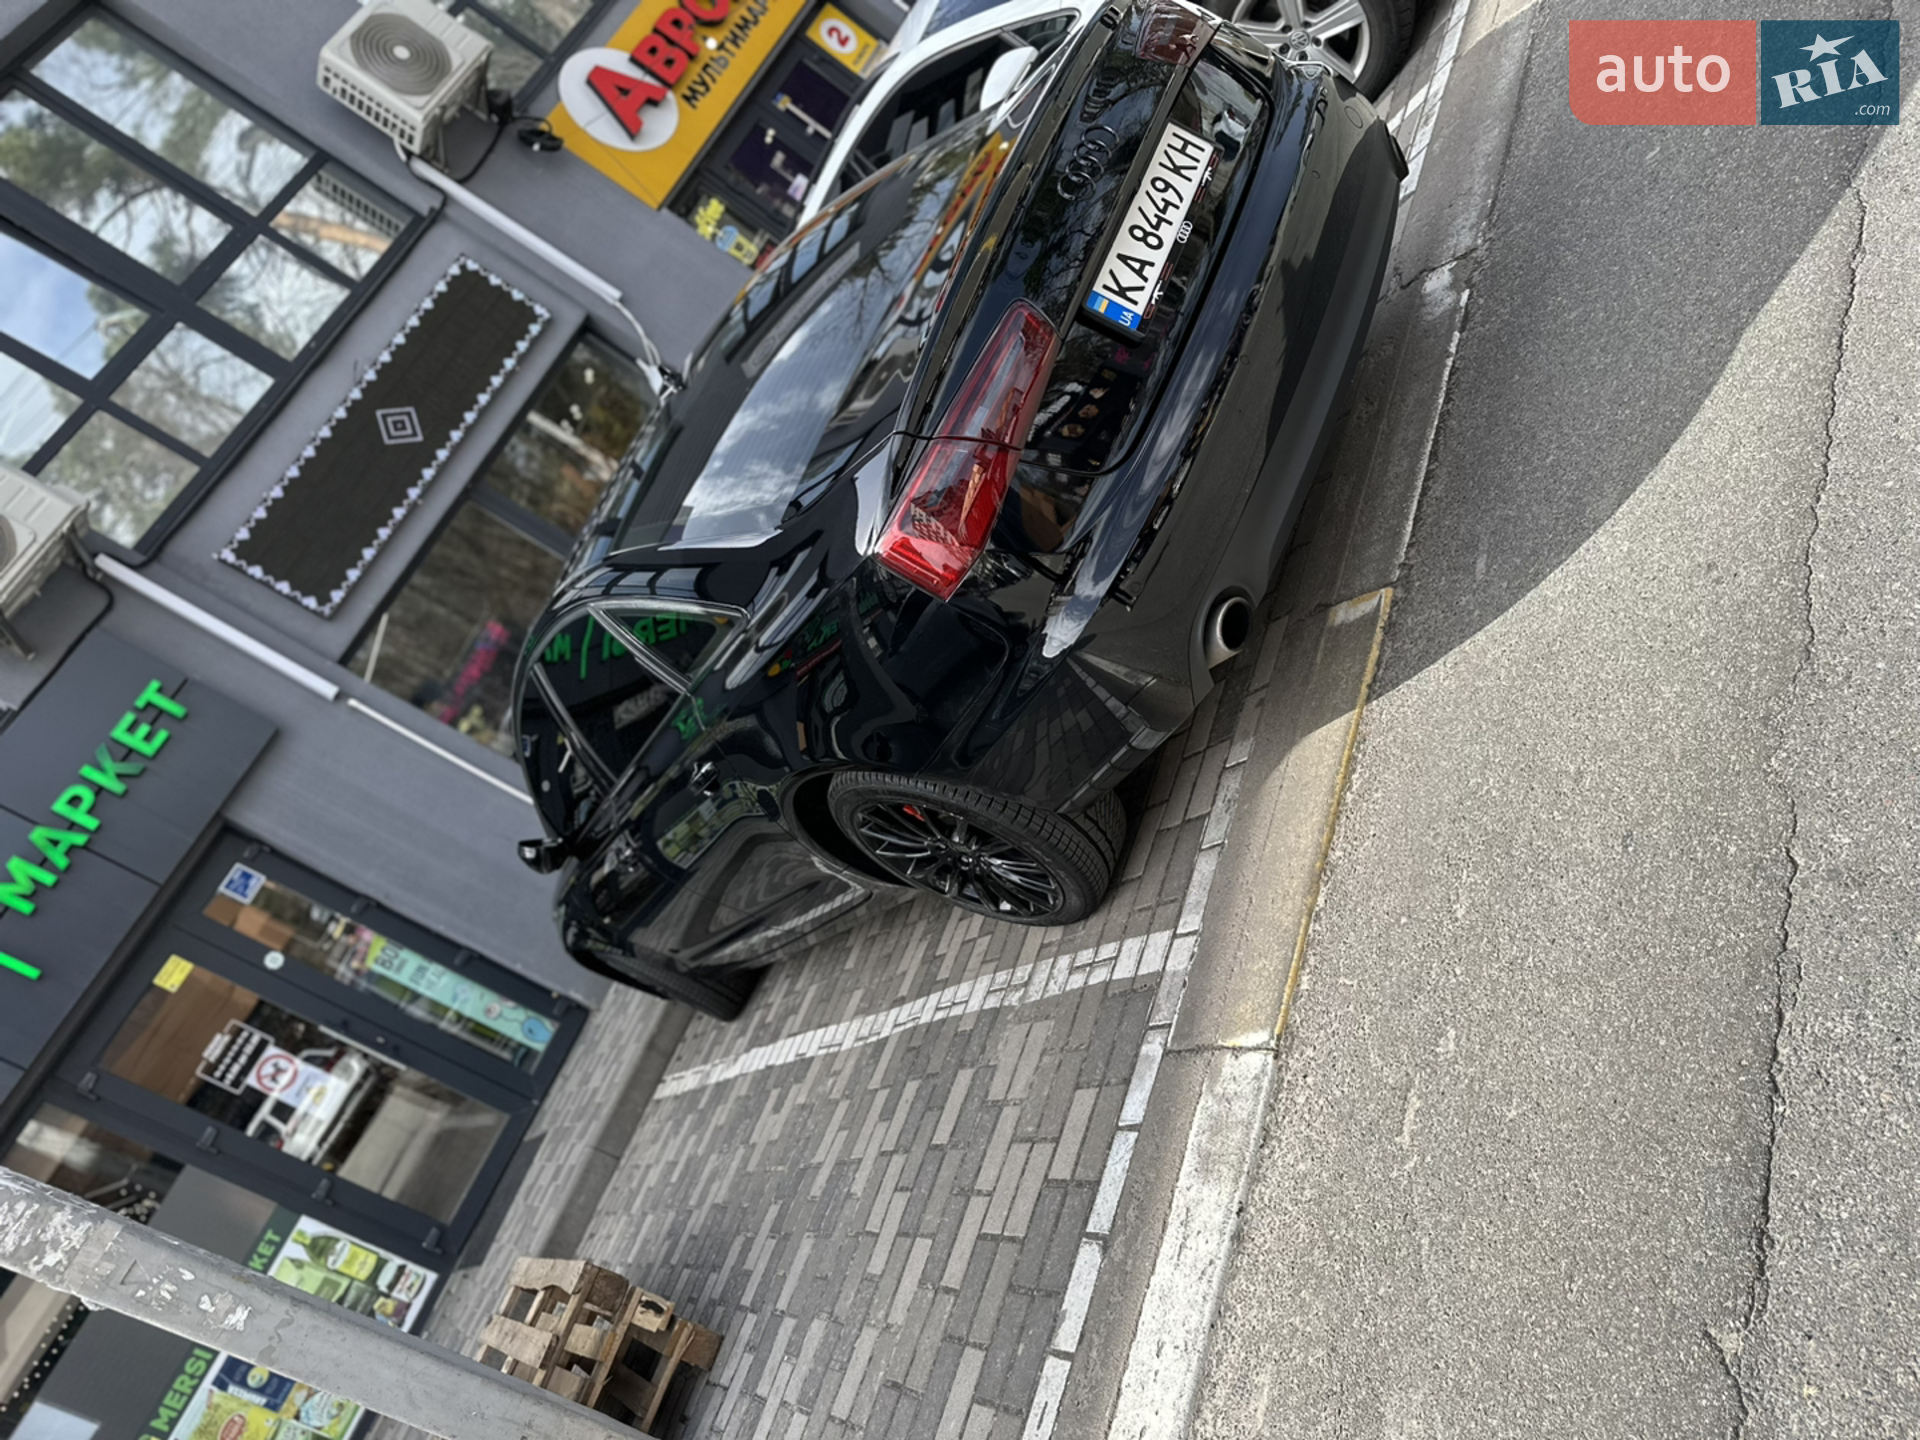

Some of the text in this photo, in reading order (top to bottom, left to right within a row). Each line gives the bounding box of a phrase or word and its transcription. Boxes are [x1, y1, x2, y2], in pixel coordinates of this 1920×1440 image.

[827, 26, 849, 48] 2
[1102, 132, 1206, 307] KA 8449 KH
[1118, 310, 1135, 327] UA
[0, 679, 188, 916] МАРКЕТ
[149, 1347, 214, 1432] MERSI
